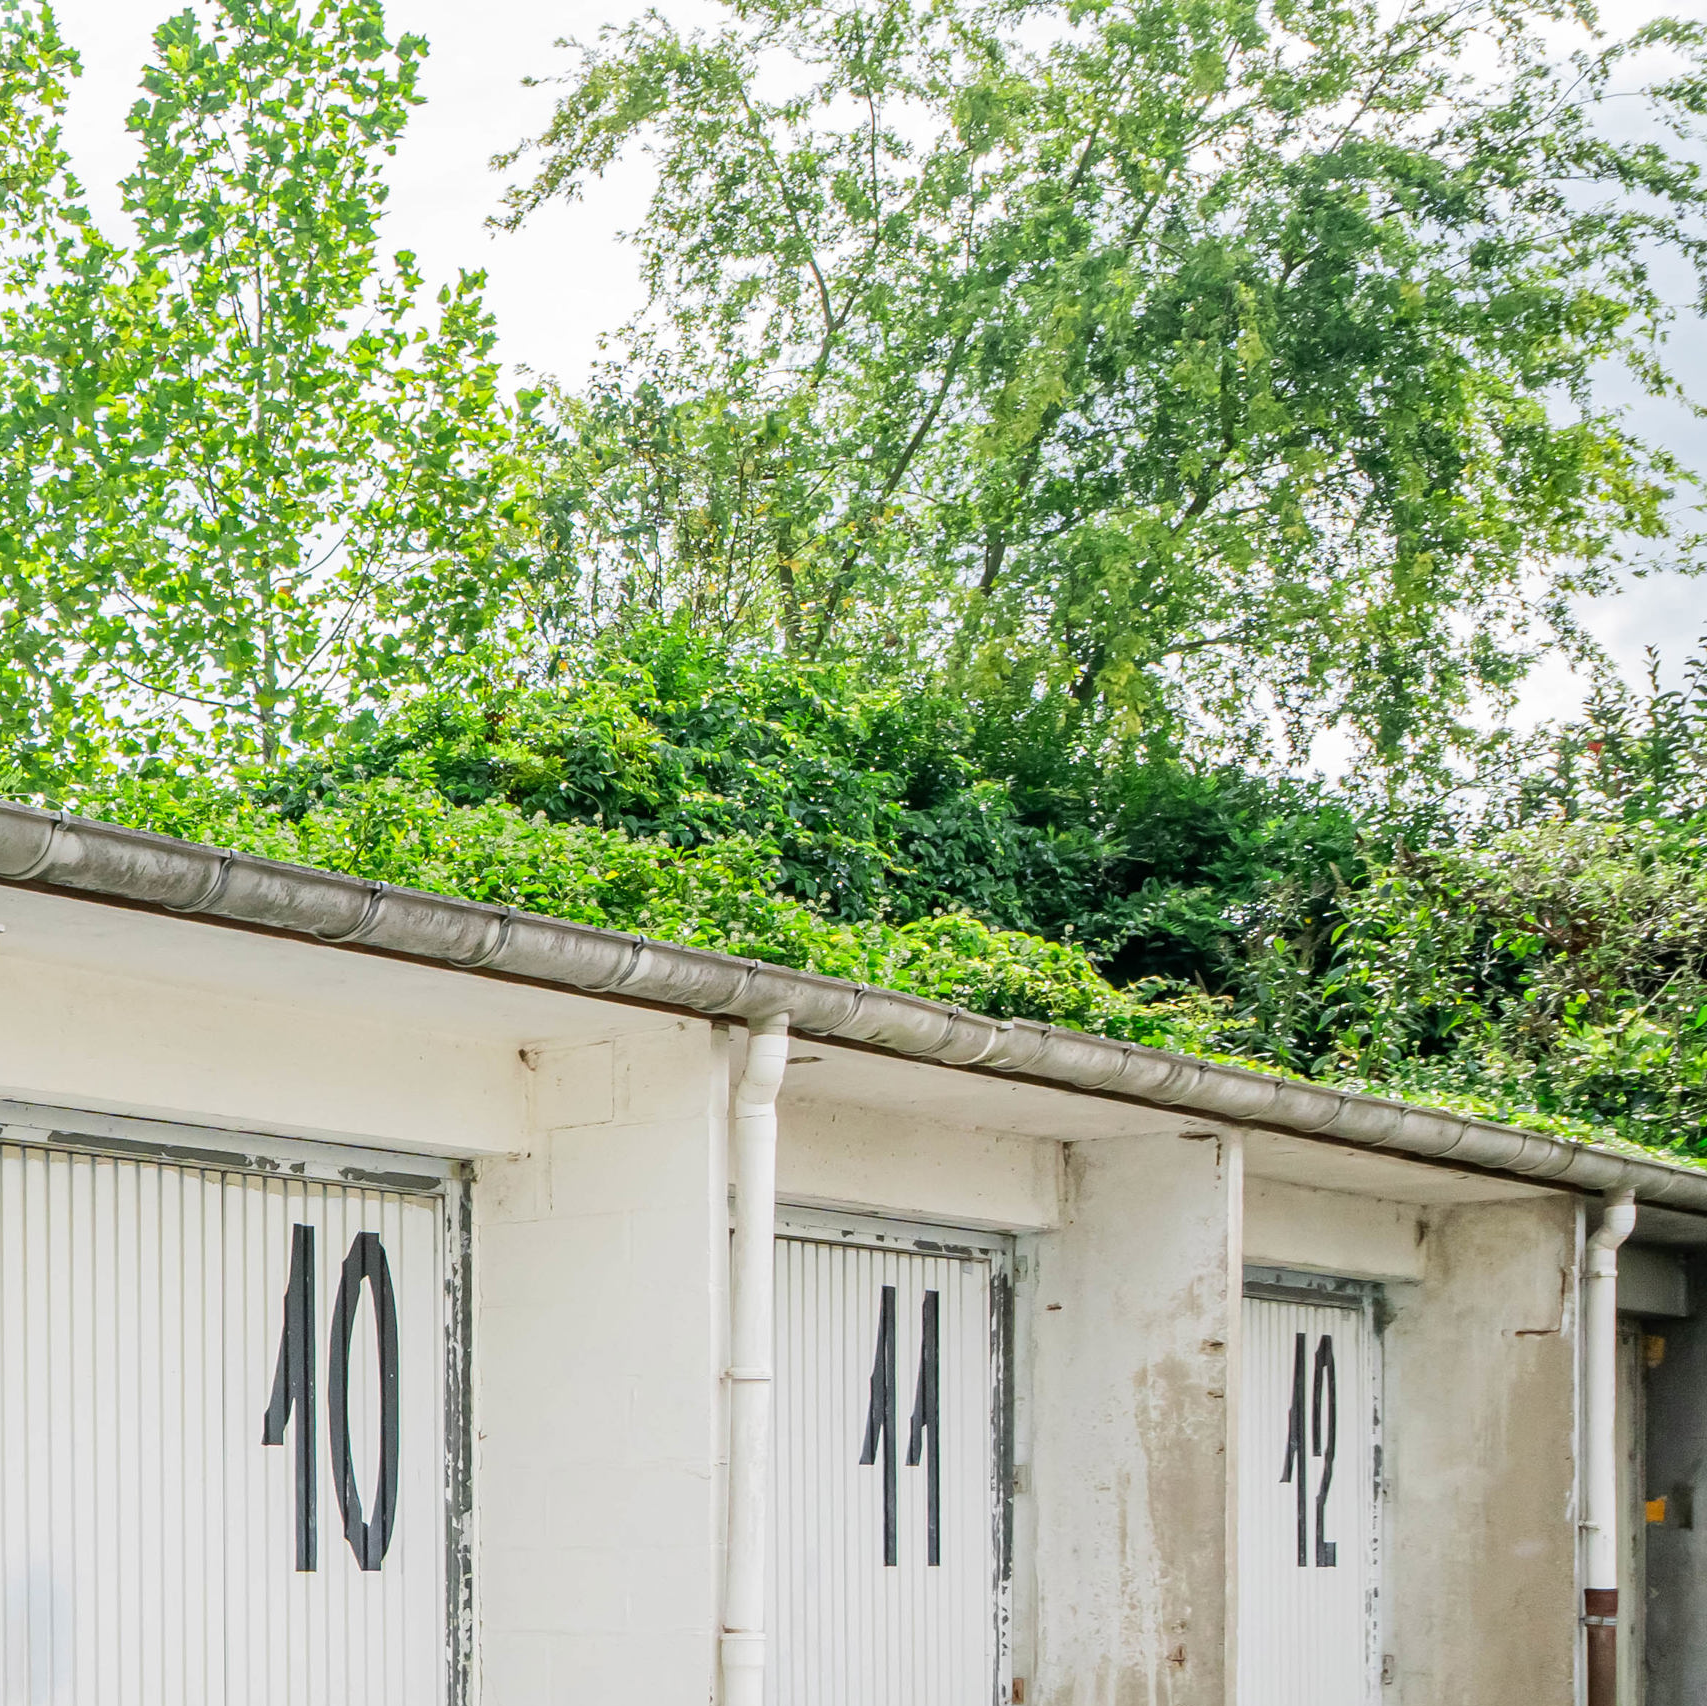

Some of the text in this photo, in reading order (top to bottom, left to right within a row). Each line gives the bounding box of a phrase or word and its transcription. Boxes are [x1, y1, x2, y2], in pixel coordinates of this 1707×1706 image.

[261, 1223, 399, 1572] 10
[859, 1285, 940, 1566] 11
[1279, 1332, 1337, 1567] 12
